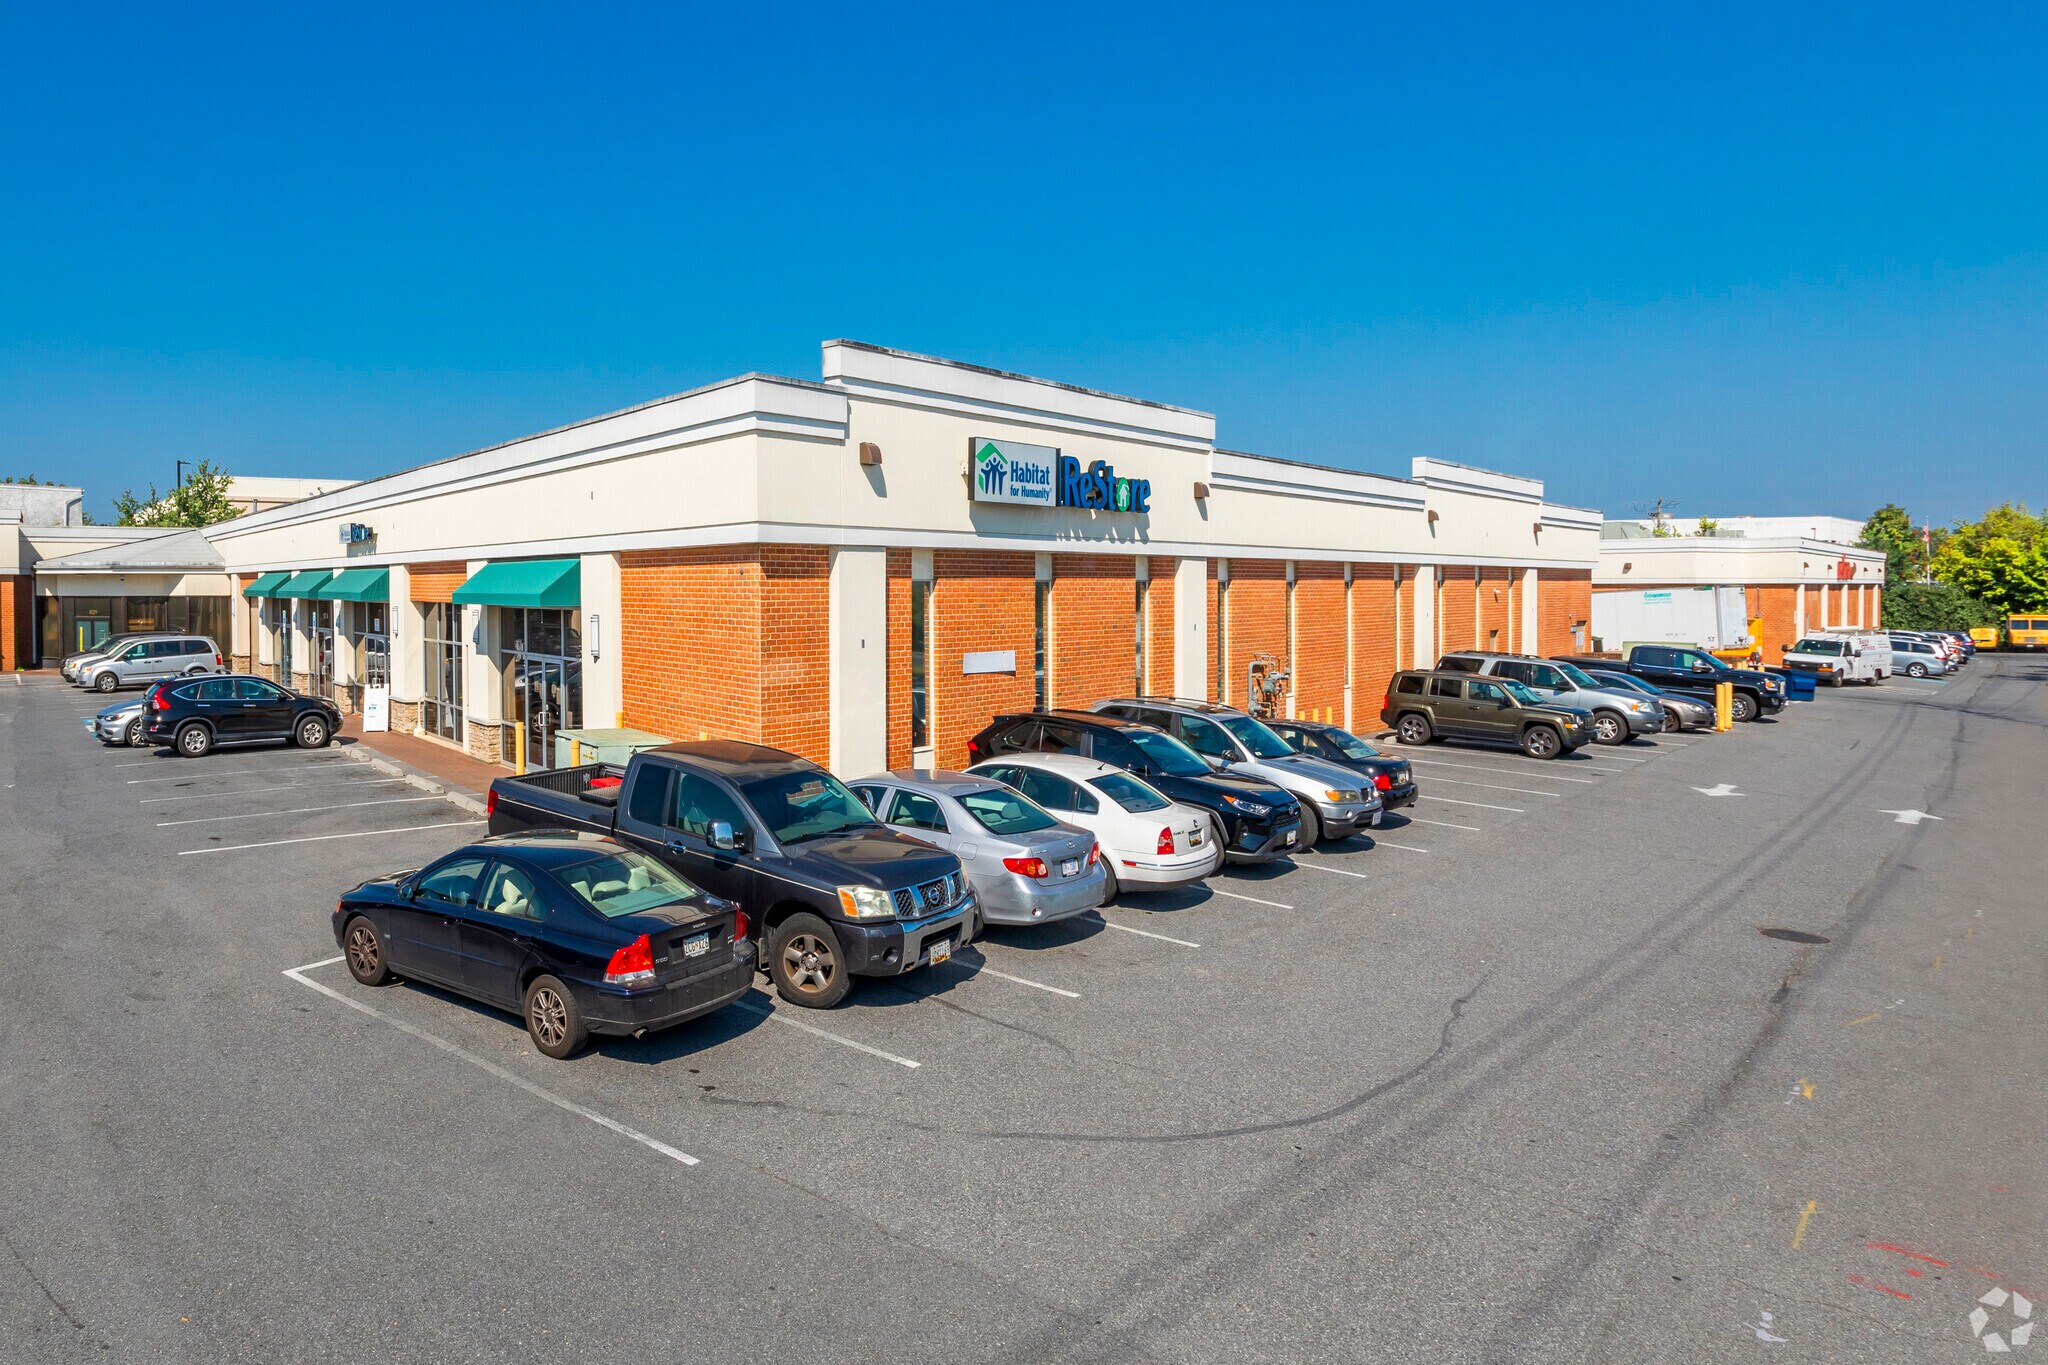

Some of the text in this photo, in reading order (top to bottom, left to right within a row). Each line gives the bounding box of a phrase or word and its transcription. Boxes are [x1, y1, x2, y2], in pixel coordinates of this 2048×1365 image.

[1010, 460, 1050, 486] Habitat
[1064, 455, 1152, 513] ReStore
[1010, 484, 1050, 502] for Humanity
